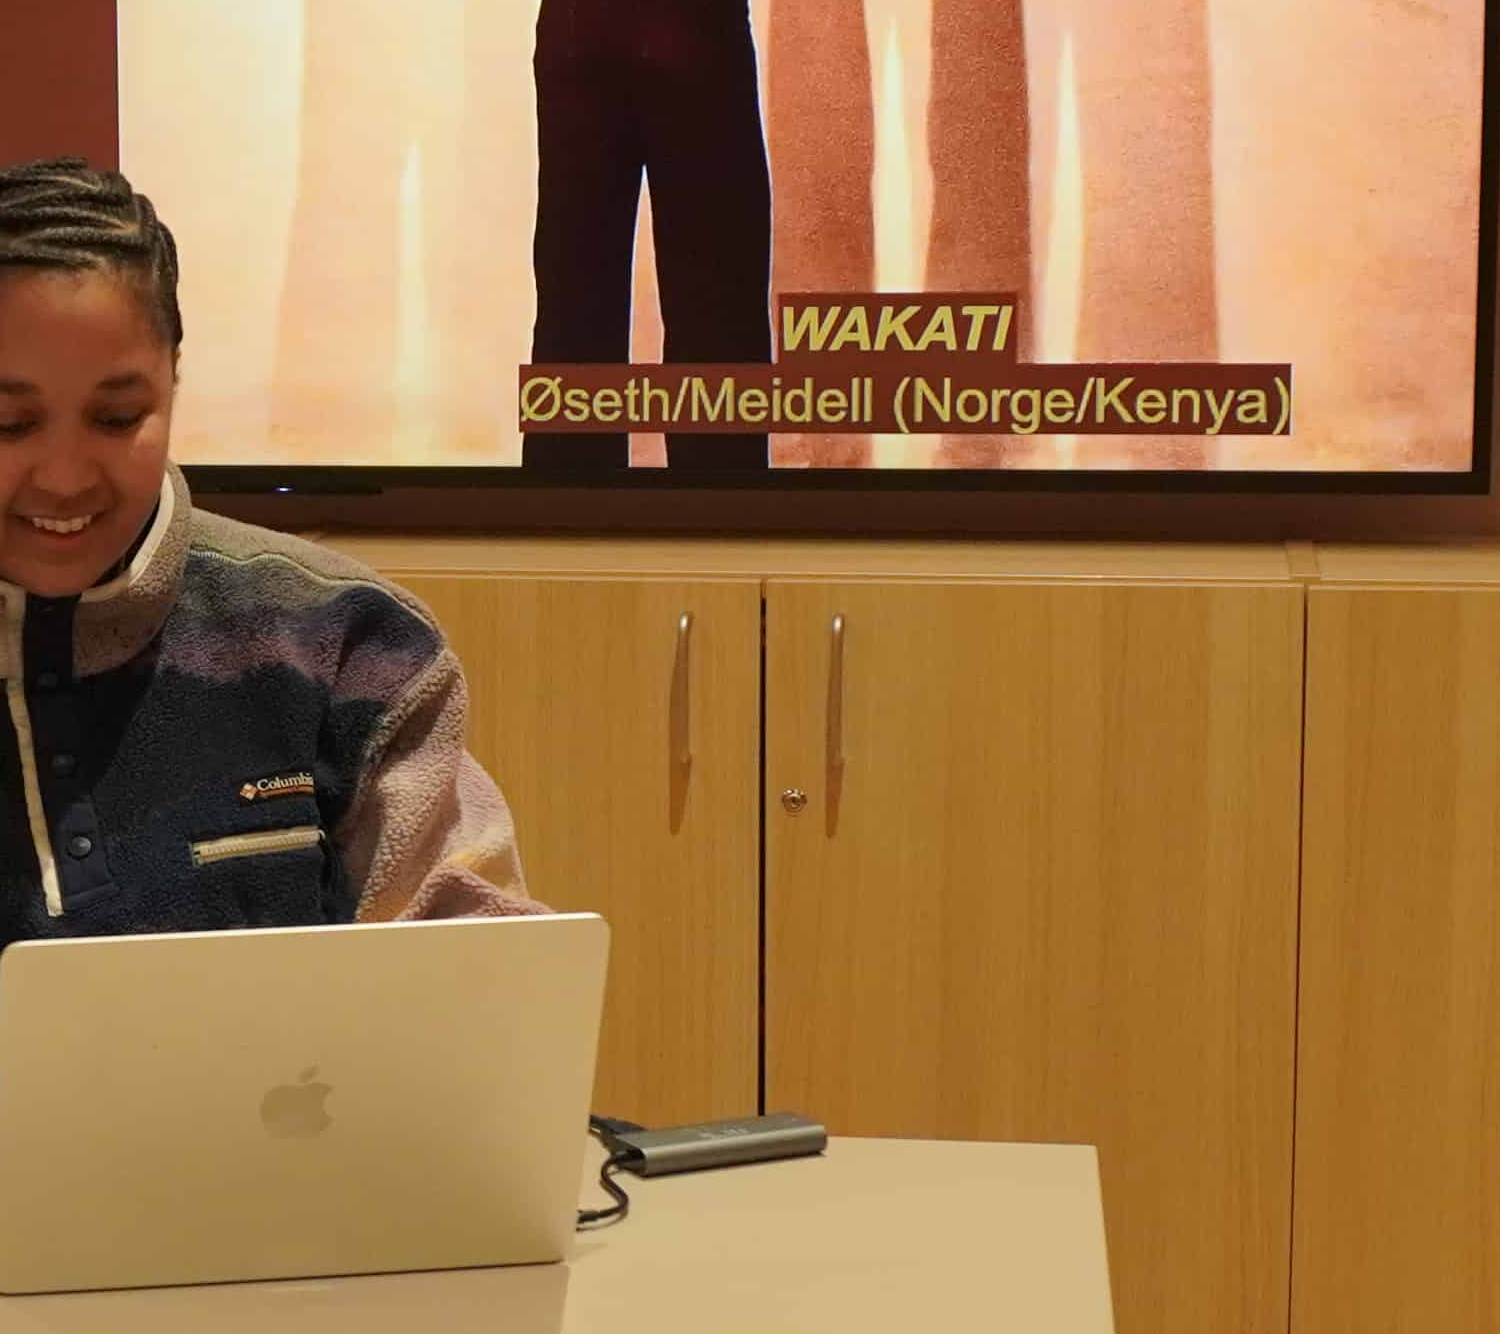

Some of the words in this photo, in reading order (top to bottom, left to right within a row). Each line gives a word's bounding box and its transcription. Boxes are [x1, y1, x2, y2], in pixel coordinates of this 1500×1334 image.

[781, 304, 1012, 352] WAKATI
[519, 375, 873, 424] Øseth/Meidell
[893, 375, 1290, 434] (Norge/Kenya)
